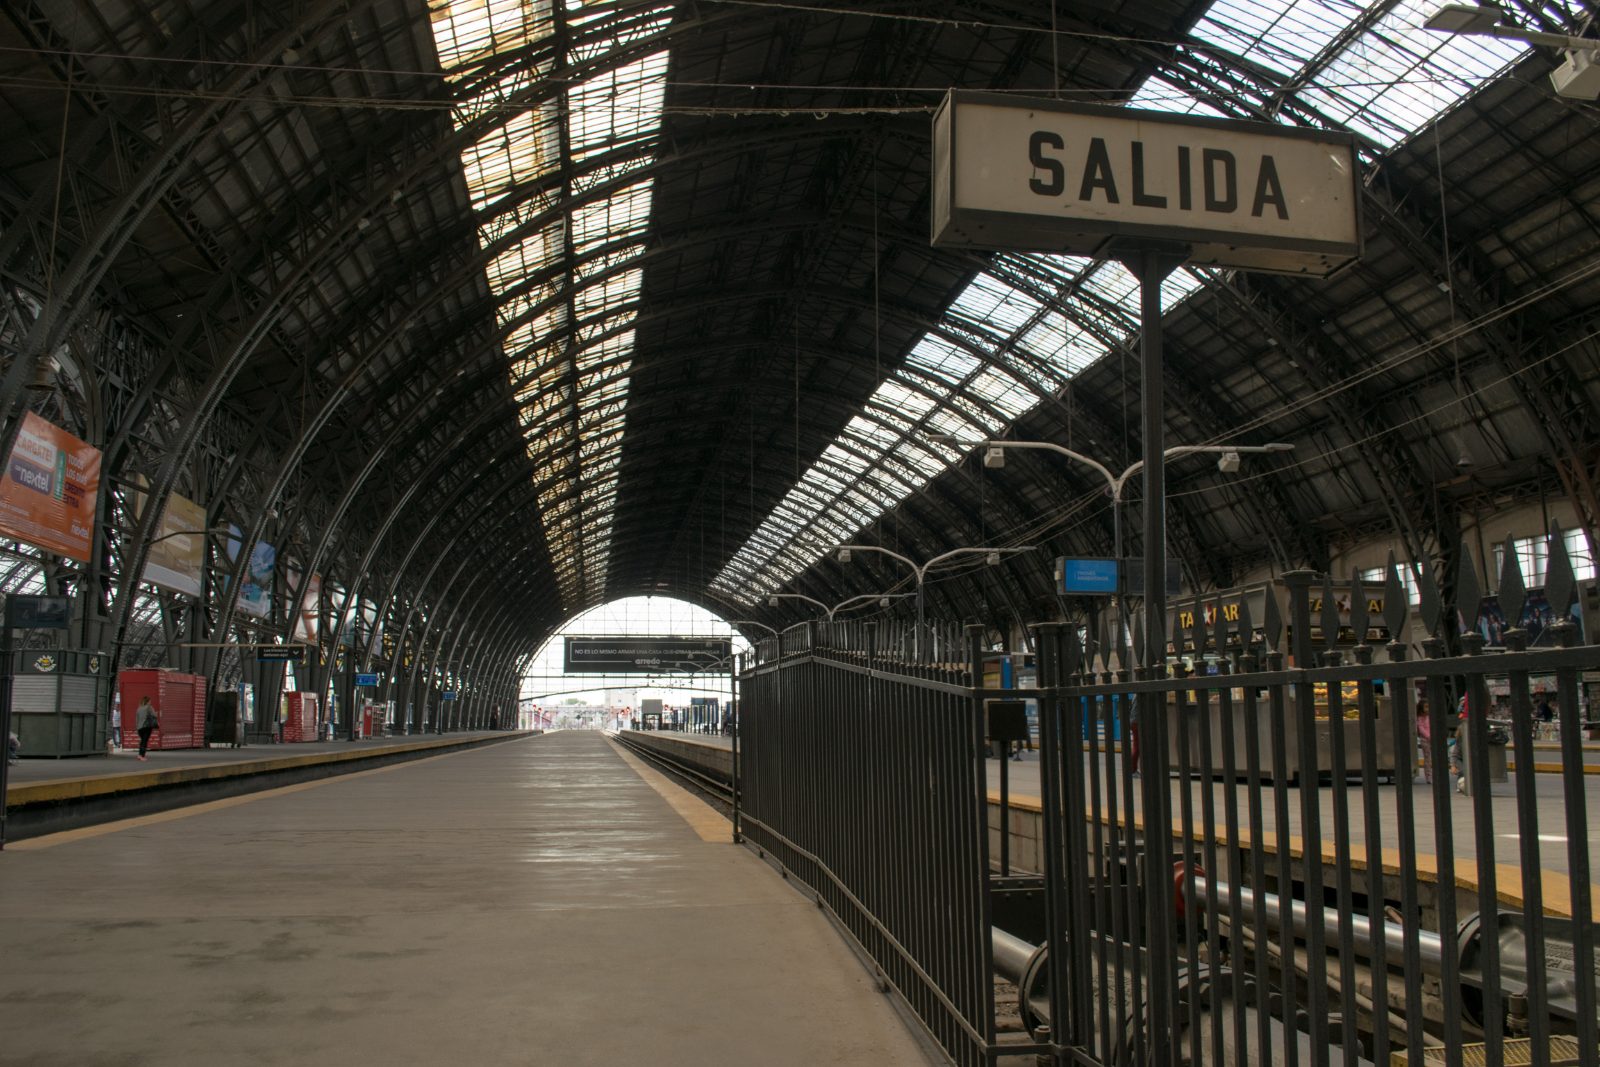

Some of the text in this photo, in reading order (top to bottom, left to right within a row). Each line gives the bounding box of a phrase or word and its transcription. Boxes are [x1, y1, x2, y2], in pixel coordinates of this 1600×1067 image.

[1029, 131, 1290, 220] SALIDA
[20, 468, 49, 492] nextel
[635, 657, 660, 665] arredo
